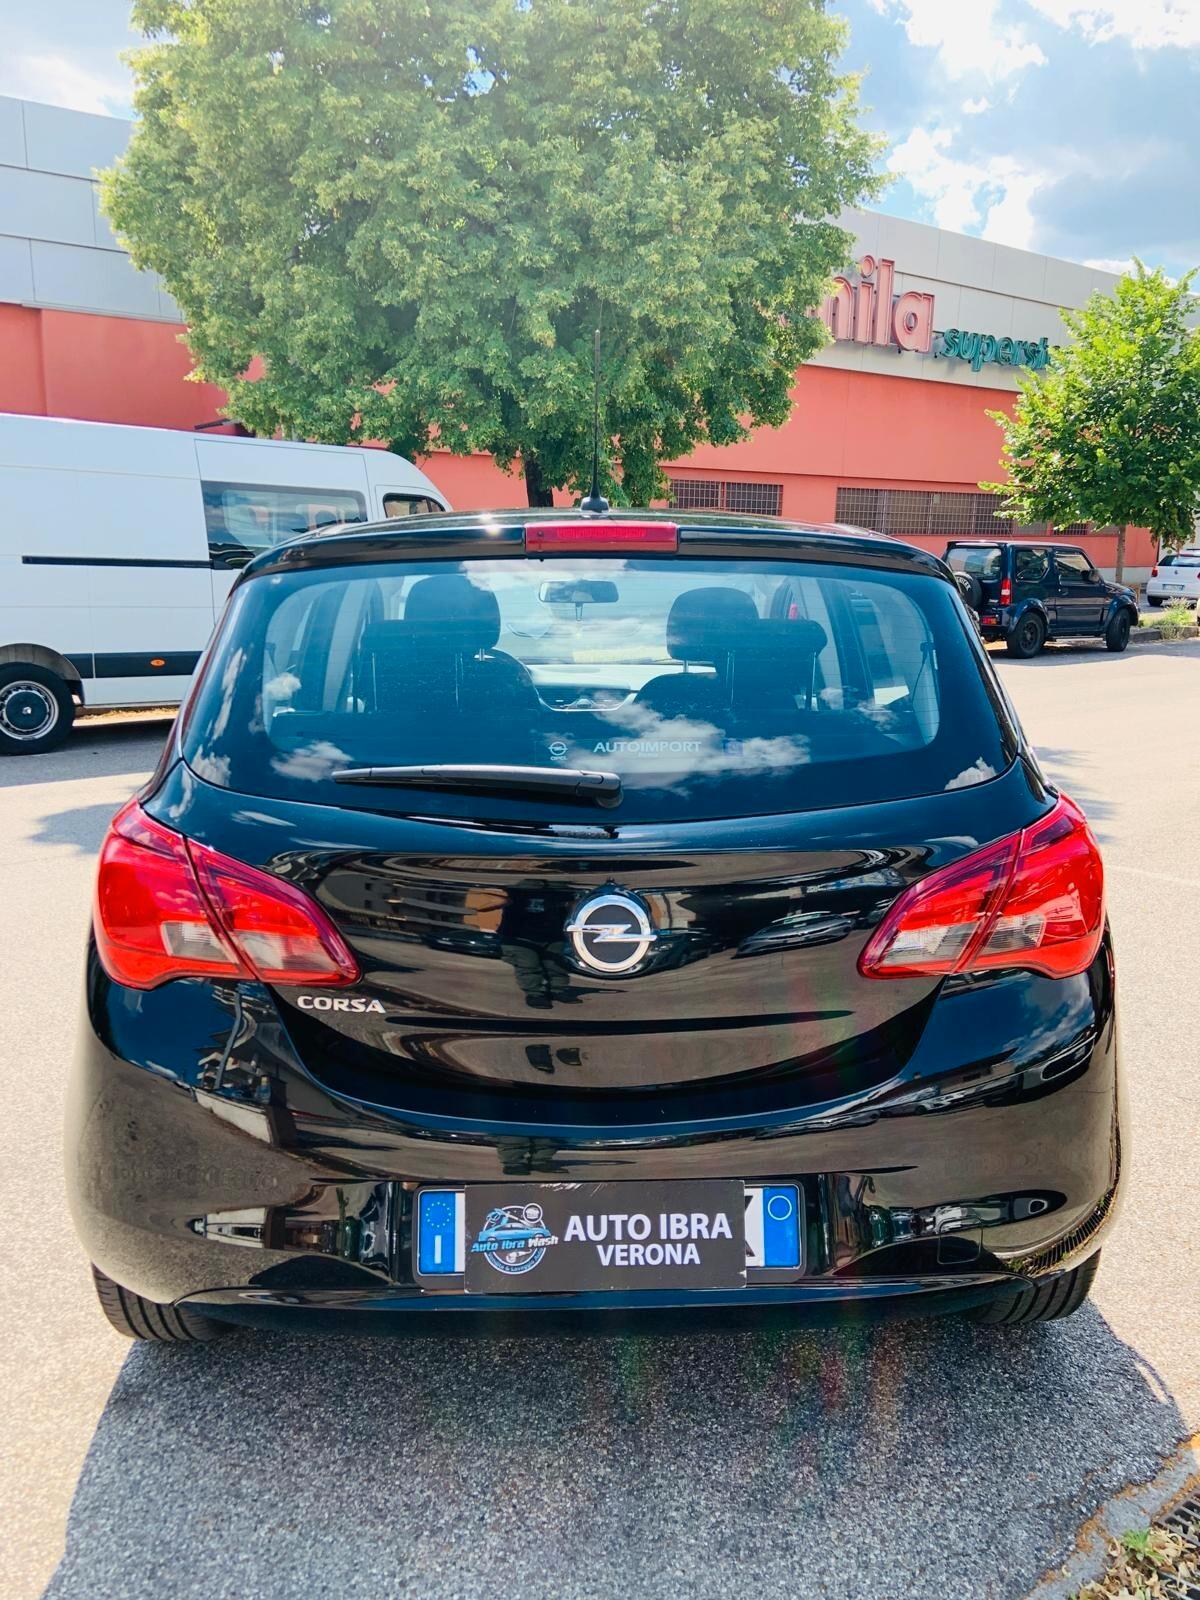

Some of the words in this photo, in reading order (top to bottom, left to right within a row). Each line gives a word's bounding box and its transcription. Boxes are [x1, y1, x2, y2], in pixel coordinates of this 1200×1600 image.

[942, 328, 1050, 372] superst
[593, 740, 702, 753] AUTOIMPORT
[297, 995, 386, 1014] CORSA
[563, 1213, 652, 1242] AUTO
[659, 1212, 733, 1240] IBRA
[471, 1241, 499, 1253] Auto
[501, 1239, 525, 1250] Ibra
[527, 1235, 559, 1248] Wash
[596, 1243, 701, 1266] VERONA
